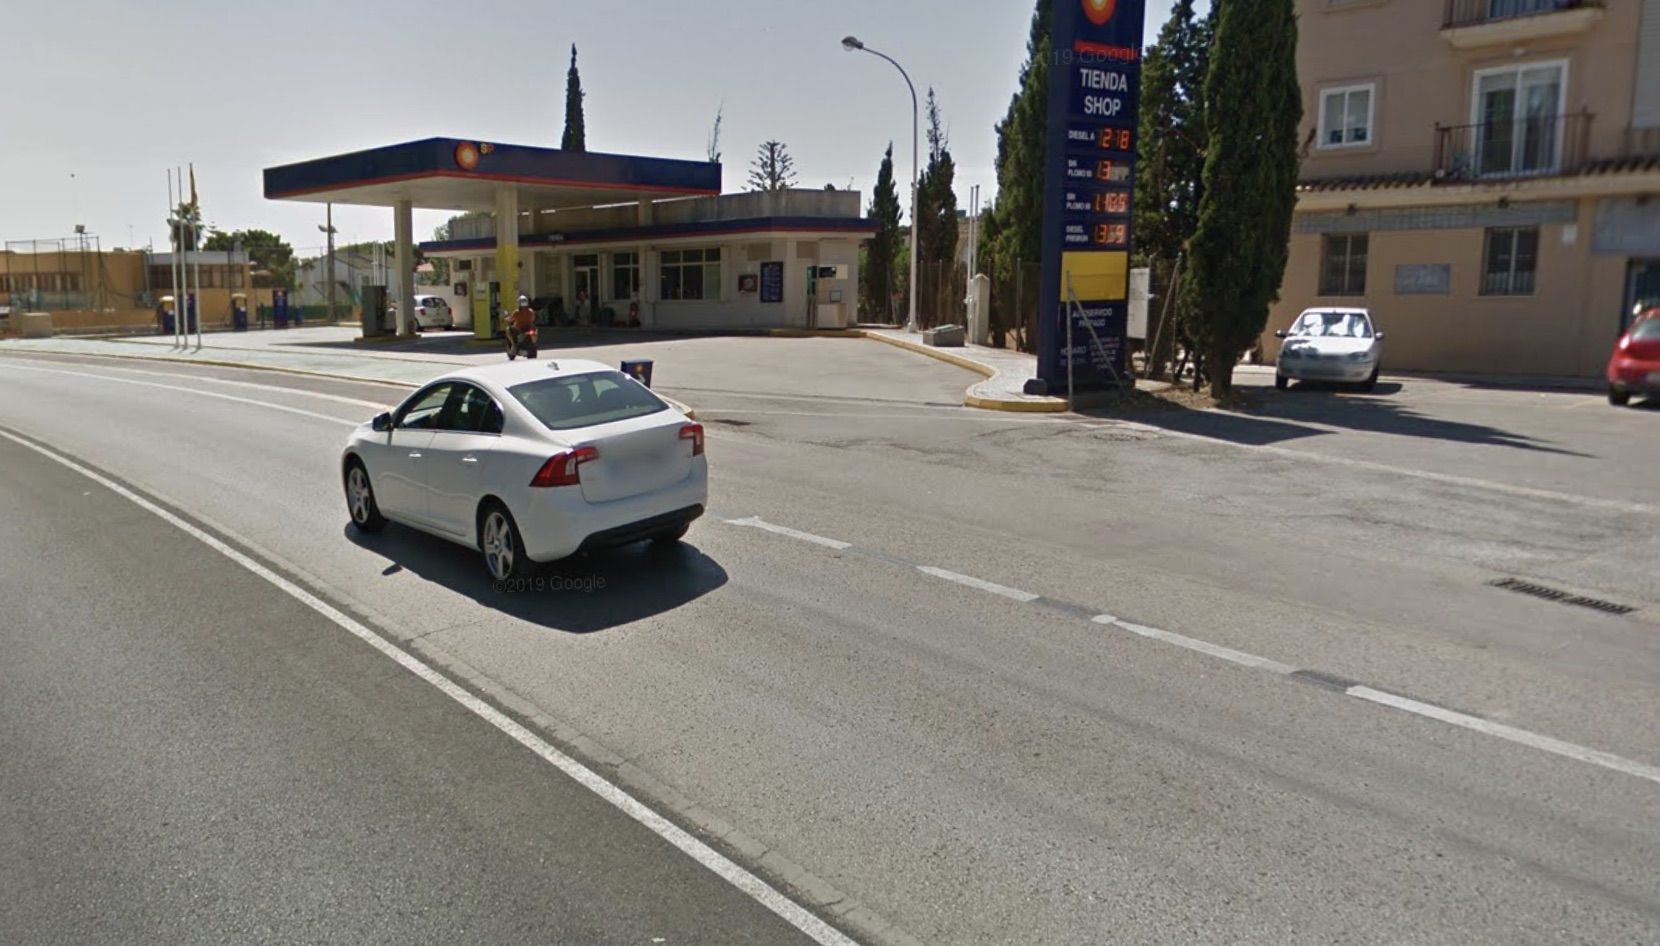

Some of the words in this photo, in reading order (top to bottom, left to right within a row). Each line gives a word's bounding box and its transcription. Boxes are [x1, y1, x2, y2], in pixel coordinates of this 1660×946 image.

[1080, 68, 1128, 92] TIENDA
[1084, 95, 1121, 117] SHOP
[1068, 129, 1089, 140] DIESEL
